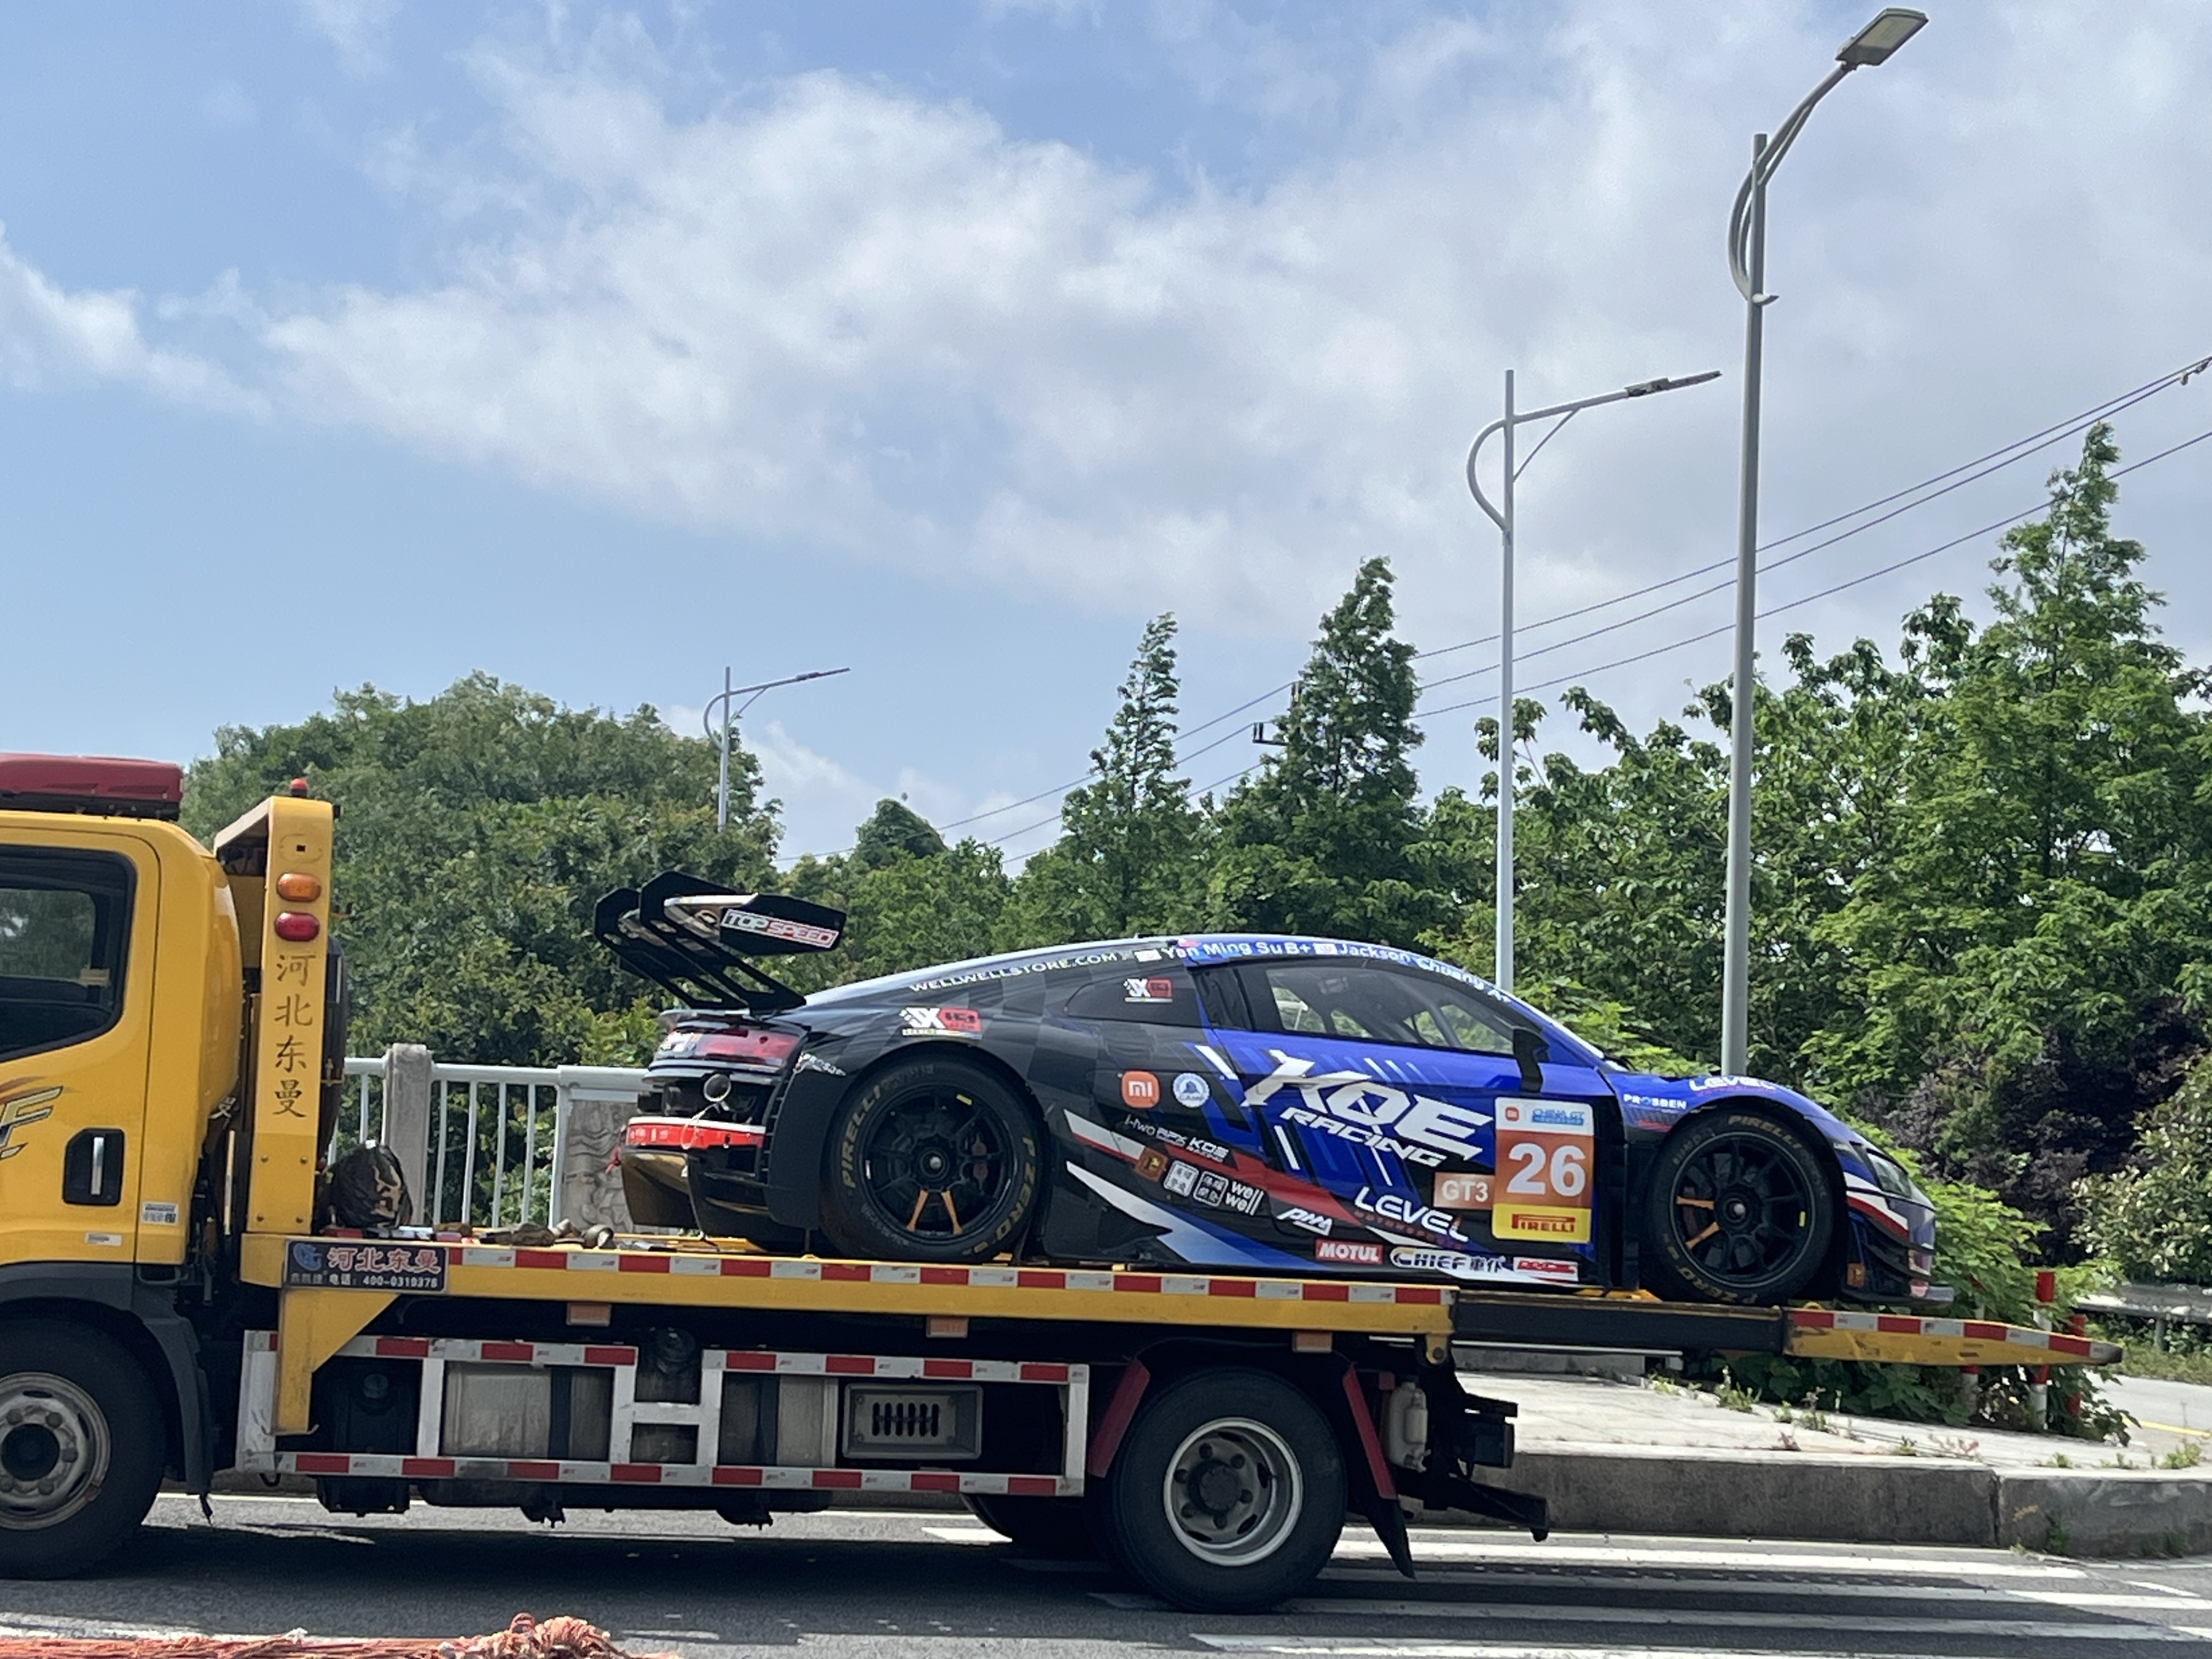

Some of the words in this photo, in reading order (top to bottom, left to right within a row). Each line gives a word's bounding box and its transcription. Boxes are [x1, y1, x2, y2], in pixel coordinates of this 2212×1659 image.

[725, 912, 769, 932] TOP
[766, 921, 836, 945] SPEED
[1205, 941, 1252, 955] Ming
[909, 952, 1118, 992] WELLWELLSTORE.COM
[1340, 943, 1410, 961] Jackson
[1417, 958, 1484, 990] Chuang
[273, 953, 317, 1118] 河北东曼
[842, 1085, 882, 1189] PIRELLI
[1022, 1136, 1036, 1157] P
[1279, 1107, 1448, 1168] RACING
[1728, 1115, 1803, 1149] PIRELLI
[1506, 1142, 1587, 1197] 26
[996, 1162, 1036, 1240] ZERO
[1441, 1179, 1489, 1203] GT3
[1354, 1186, 1470, 1243] LEVEL
[1511, 1214, 1576, 1233] PIRELLI
[326, 1246, 442, 1274] 河北东曼
[1318, 1242, 1379, 1261] MOTUL
[1392, 1248, 1467, 1270] CHIEF
